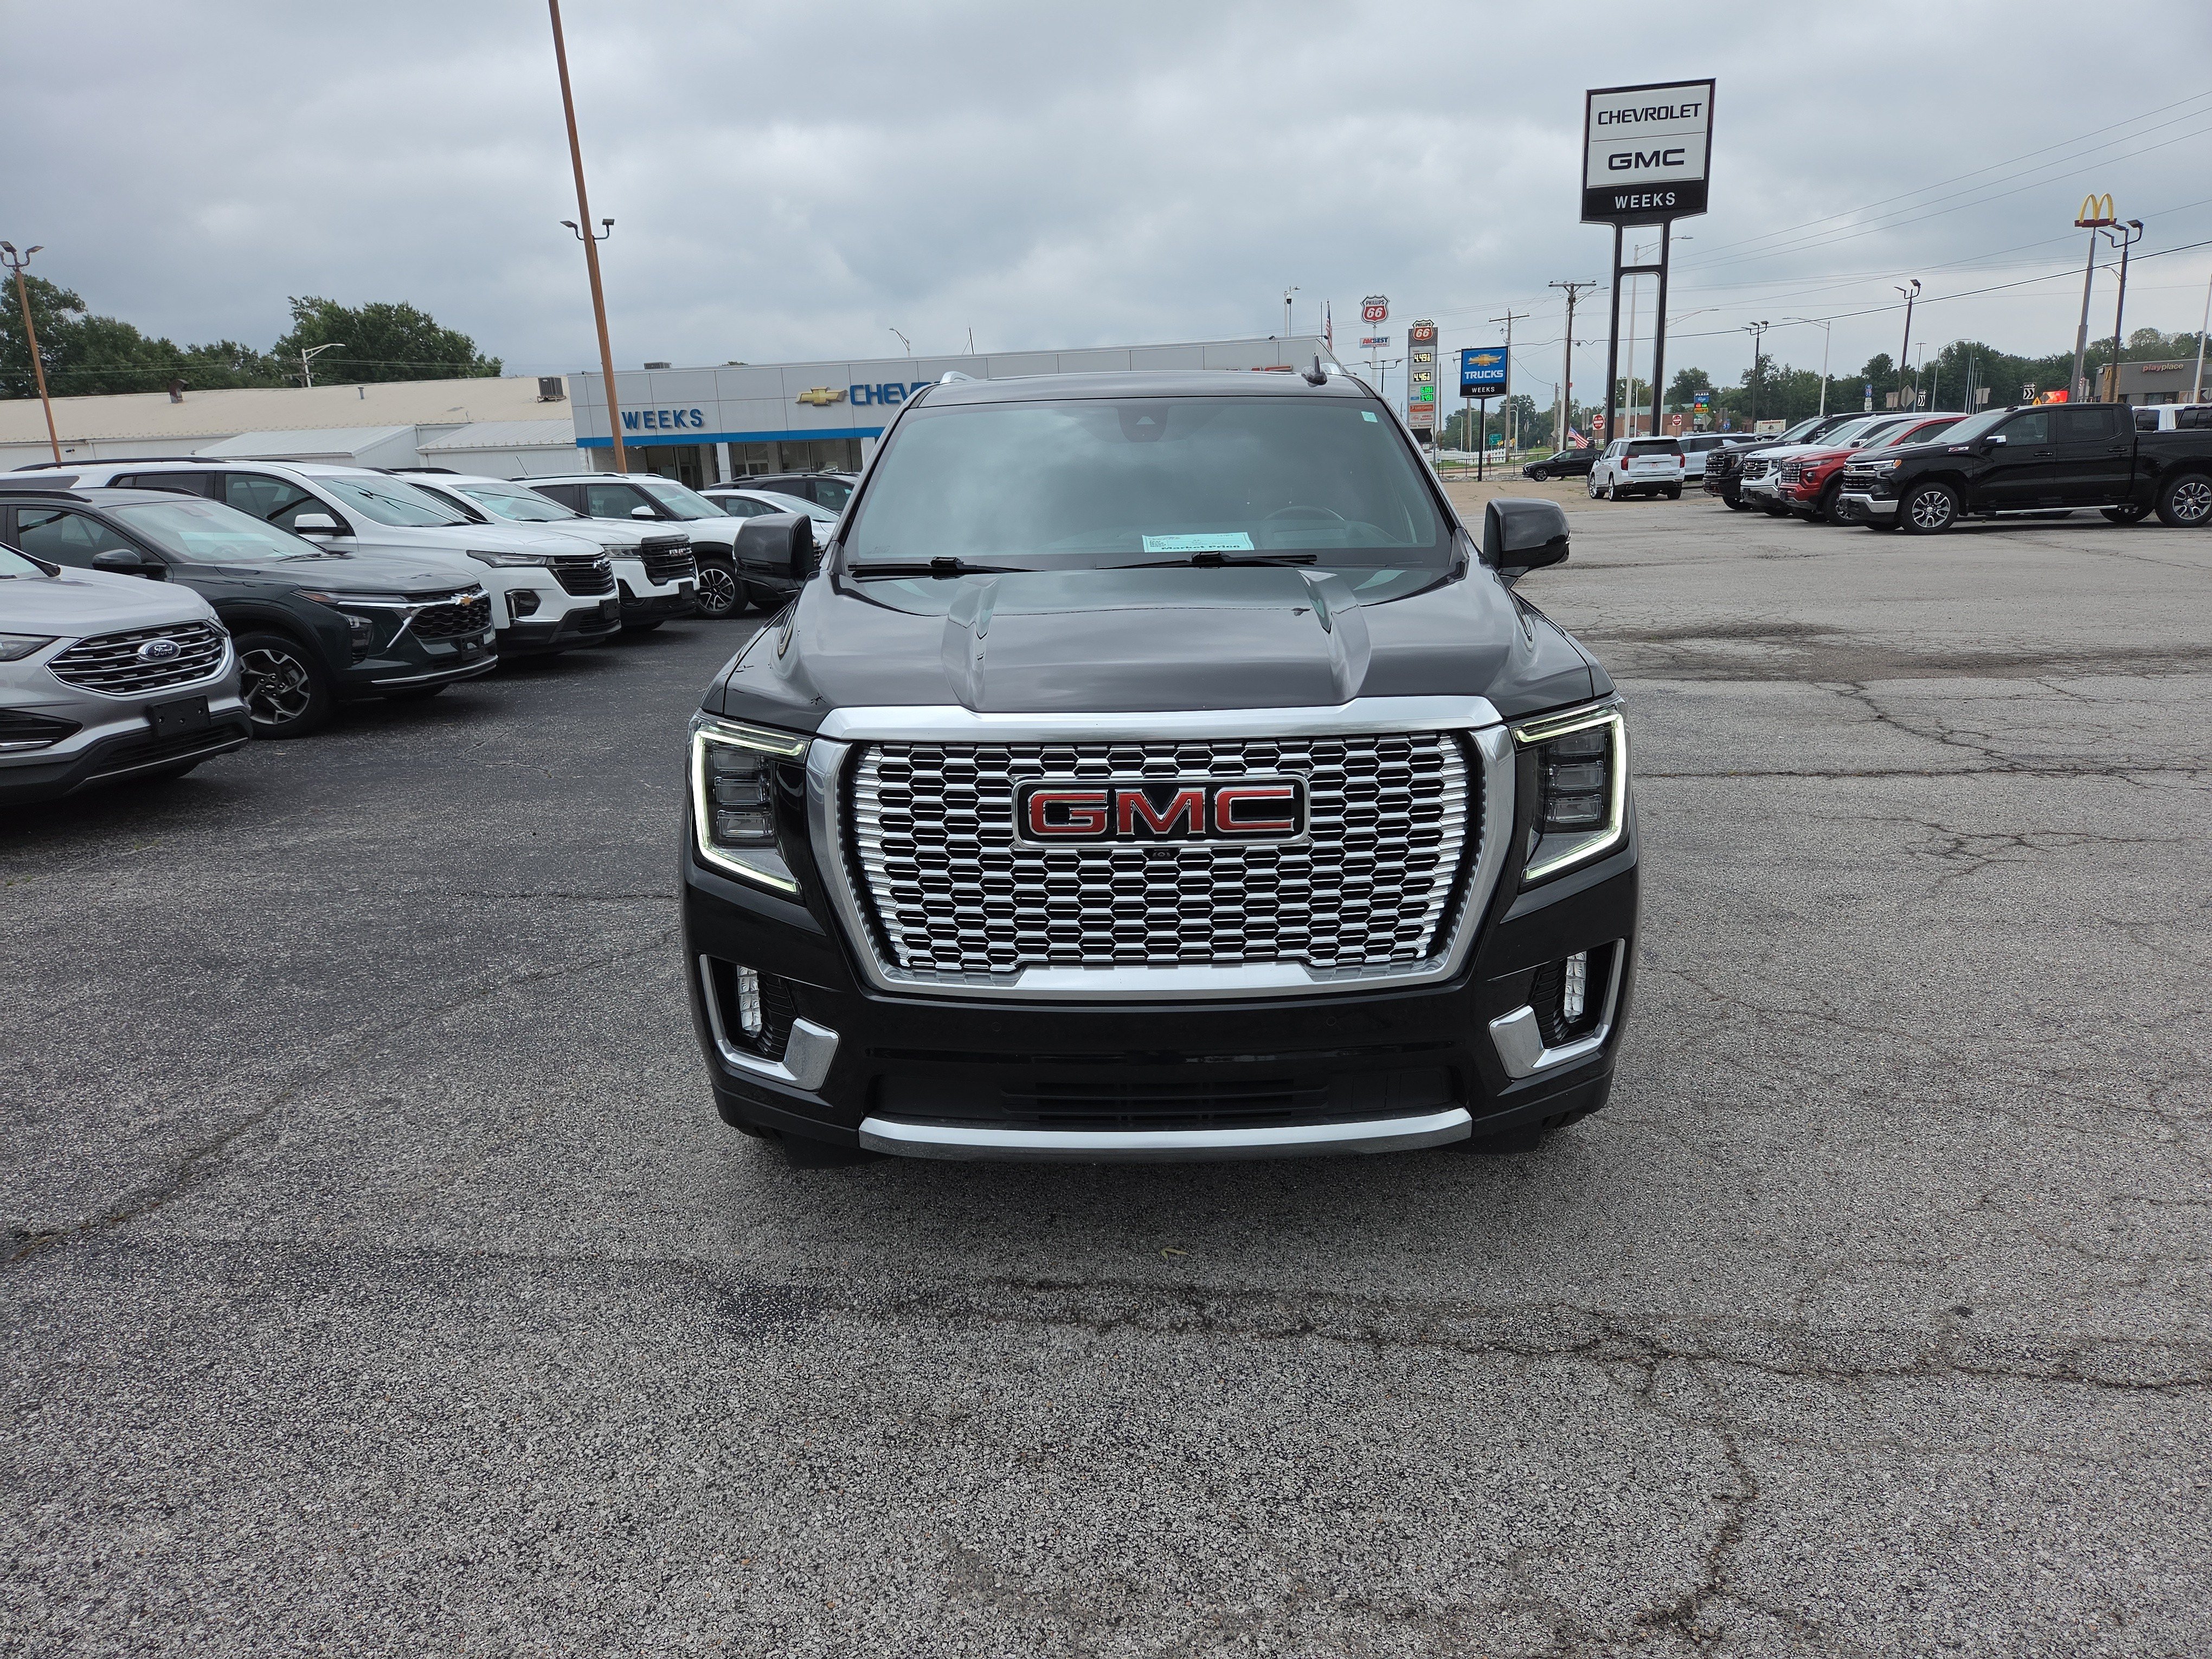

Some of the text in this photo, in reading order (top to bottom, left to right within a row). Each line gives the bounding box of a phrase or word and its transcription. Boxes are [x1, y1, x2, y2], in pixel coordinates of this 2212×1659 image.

[1598, 102, 1702, 125] CHEVROLET
[1608, 148, 1685, 170] GMC
[1615, 192, 1675, 209] WEEKS
[1367, 307, 1383, 318] 66
[1416, 328, 1430, 338] 66
[1464, 370, 1504, 380] TRUCKS
[2143, 363, 2184, 372] playplace
[850, 381, 940, 406] CHEV
[621, 408, 704, 429] WEEKS
[154, 644, 173, 657] Ford
[1028, 785, 1295, 835] GMC
